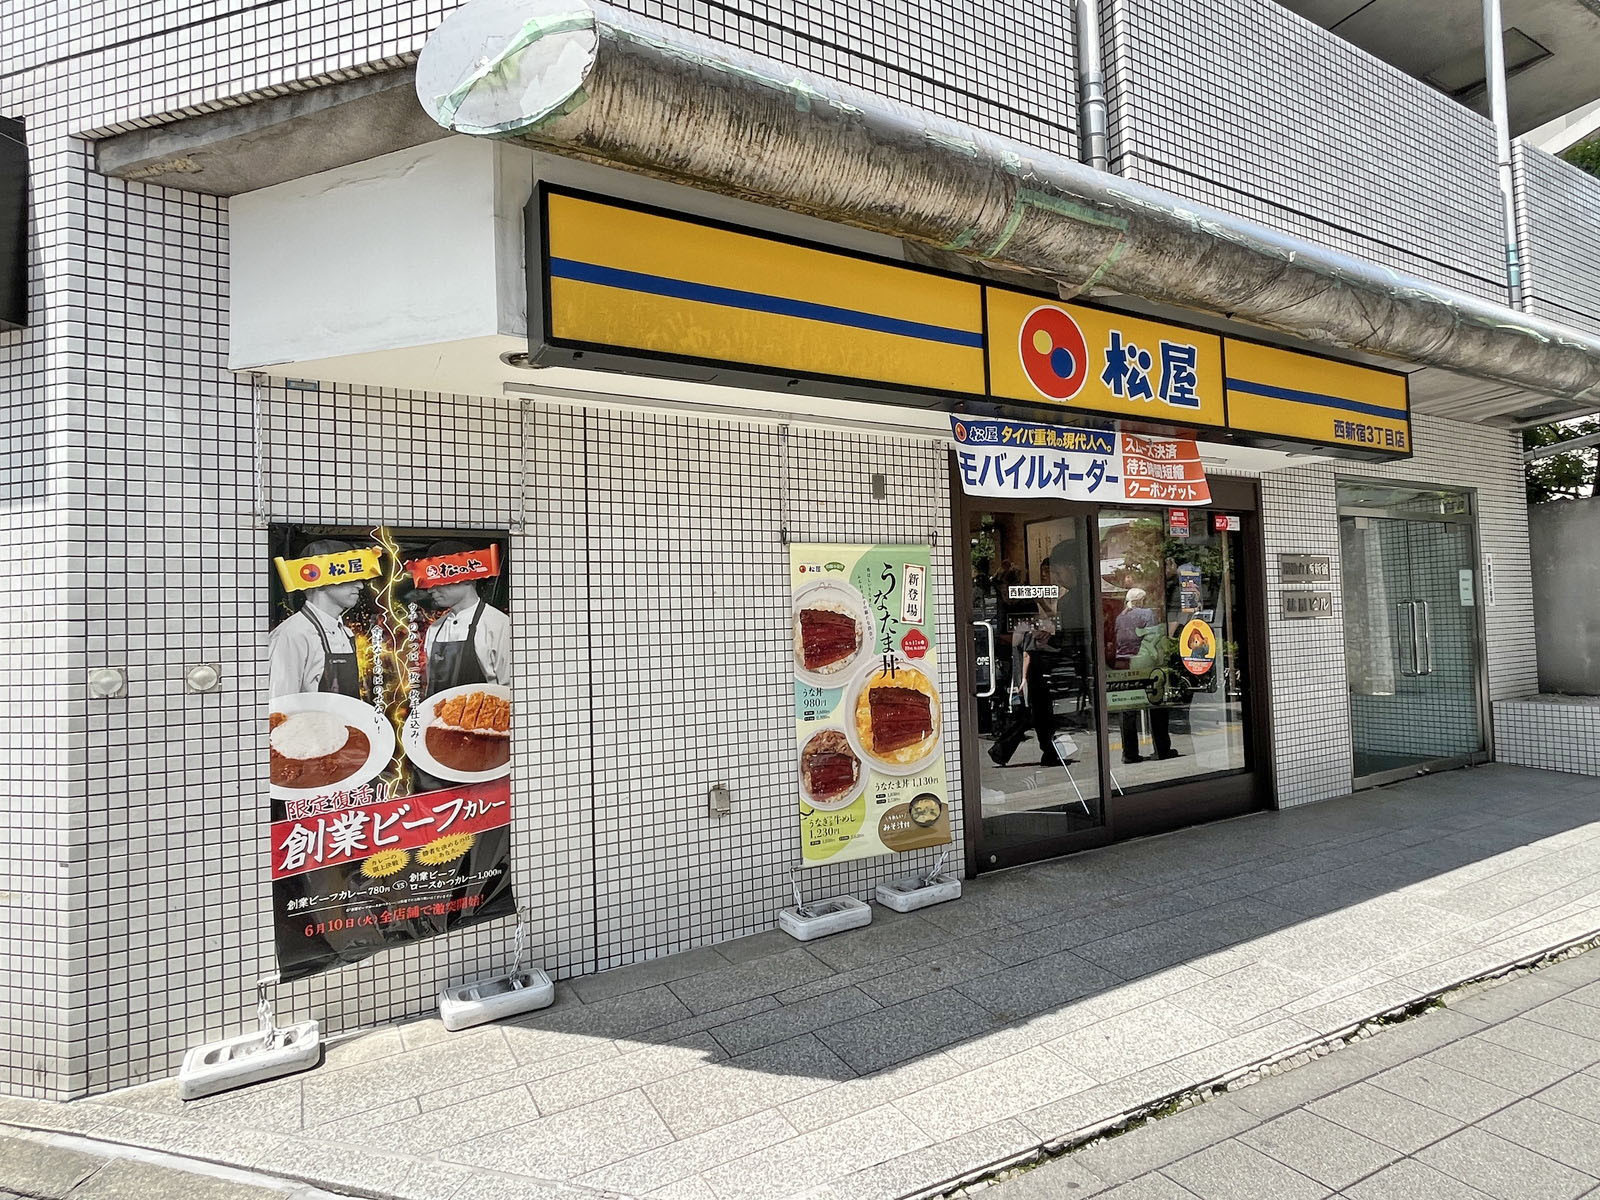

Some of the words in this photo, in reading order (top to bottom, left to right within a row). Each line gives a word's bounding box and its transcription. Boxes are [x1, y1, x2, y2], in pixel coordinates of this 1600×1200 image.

[1100, 330, 1200, 409] 松屋
[969, 426, 999, 442] 松屋
[1001, 428, 1112, 453] タイパ重視の現代人へ。
[1333, 419, 1405, 449] 西新宿3丁目店
[959, 451, 1119, 493] モバイルオーダー
[1126, 458, 1185, 480] 待ち時間短縮
[1128, 481, 1197, 499] クーポンゲット
[328, 559, 364, 577] 松屋
[438, 558, 483, 577] 松のや
[906, 573, 919, 617] 新登場
[1009, 586, 1059, 598] 西新宿3丁目店
[873, 562, 901, 680] うなたま丼
[803, 687, 824, 698] うな丼
[803, 697, 827, 709] 980円
[875, 778, 910, 791] うなたま丼
[278, 798, 506, 871] 創業ビーフカレー
[810, 827, 840, 839] 1,230円
[371, 854, 397, 866] カレーの
[409, 869, 456, 883] 創業ビーフ
